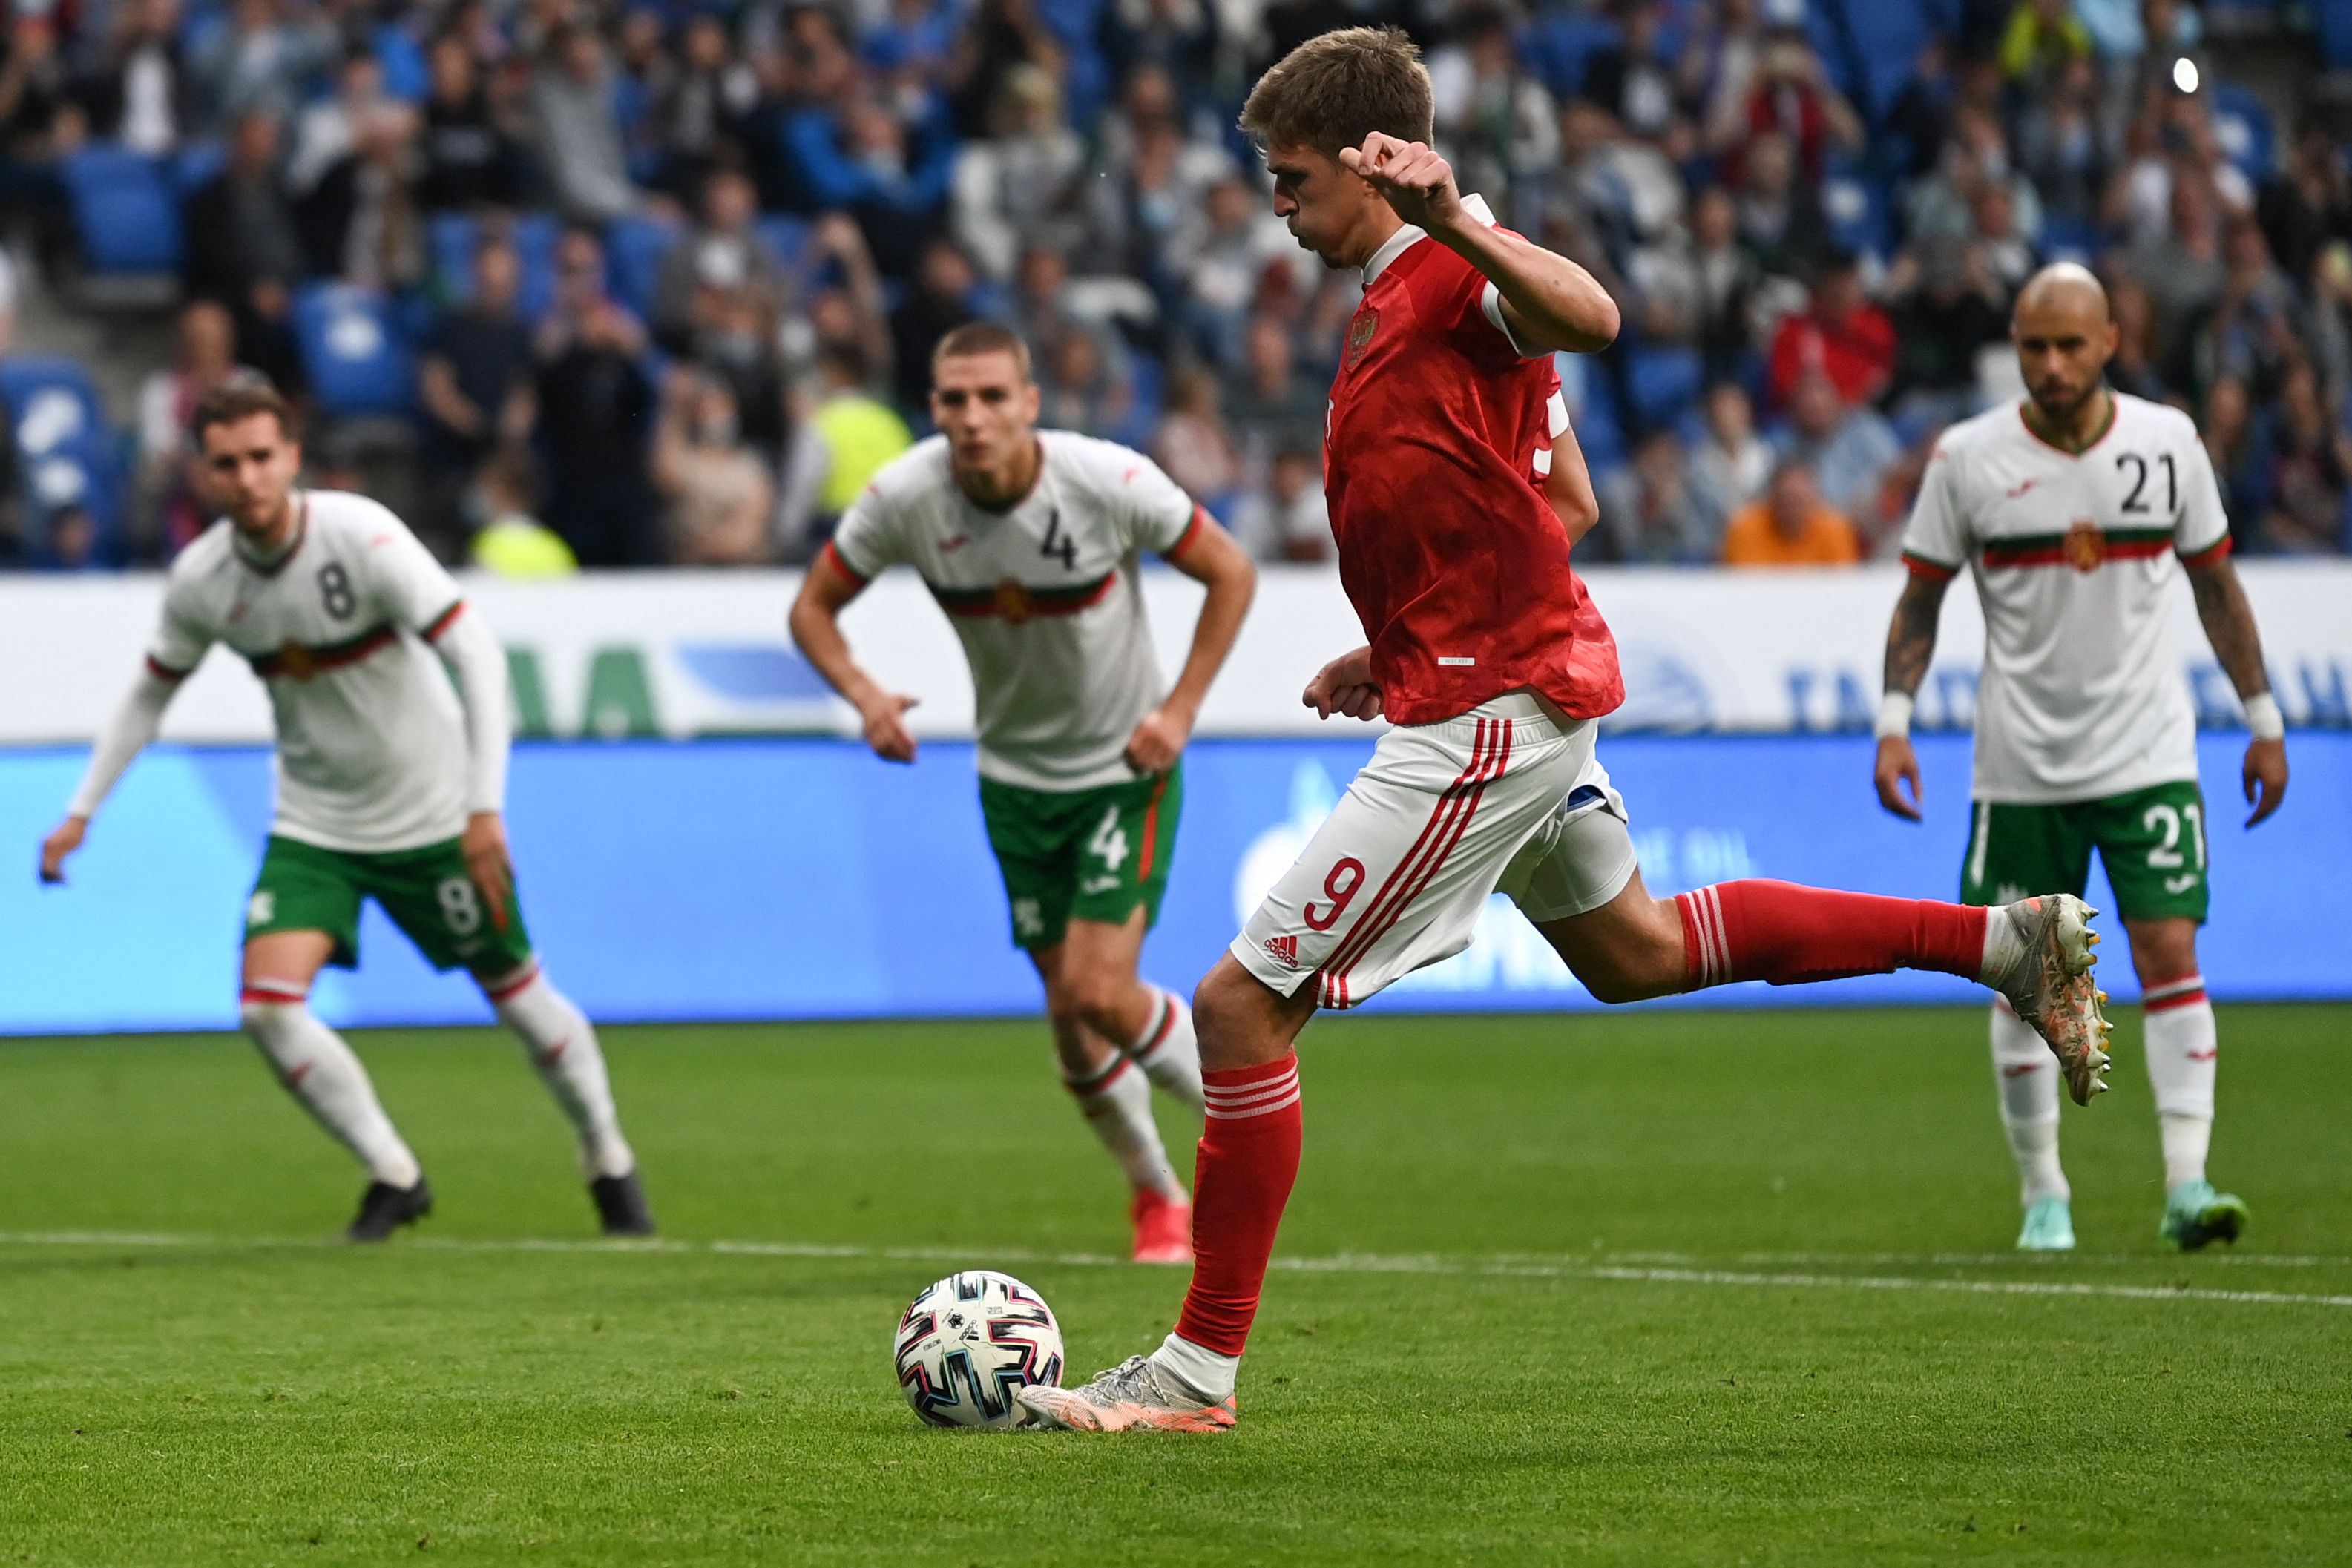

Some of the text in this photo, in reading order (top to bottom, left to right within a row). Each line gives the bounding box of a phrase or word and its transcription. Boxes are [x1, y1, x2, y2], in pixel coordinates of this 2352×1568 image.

[2116, 453, 2176, 513] 21
[1041, 507, 1079, 571] 4
[317, 562, 357, 621] 8
[1090, 804, 1129, 870] 4
[2144, 805, 2204, 869] 21
[439, 878, 480, 934] 8
[1304, 857, 1366, 931] 9
[1264, 939, 1299, 969] adidas
